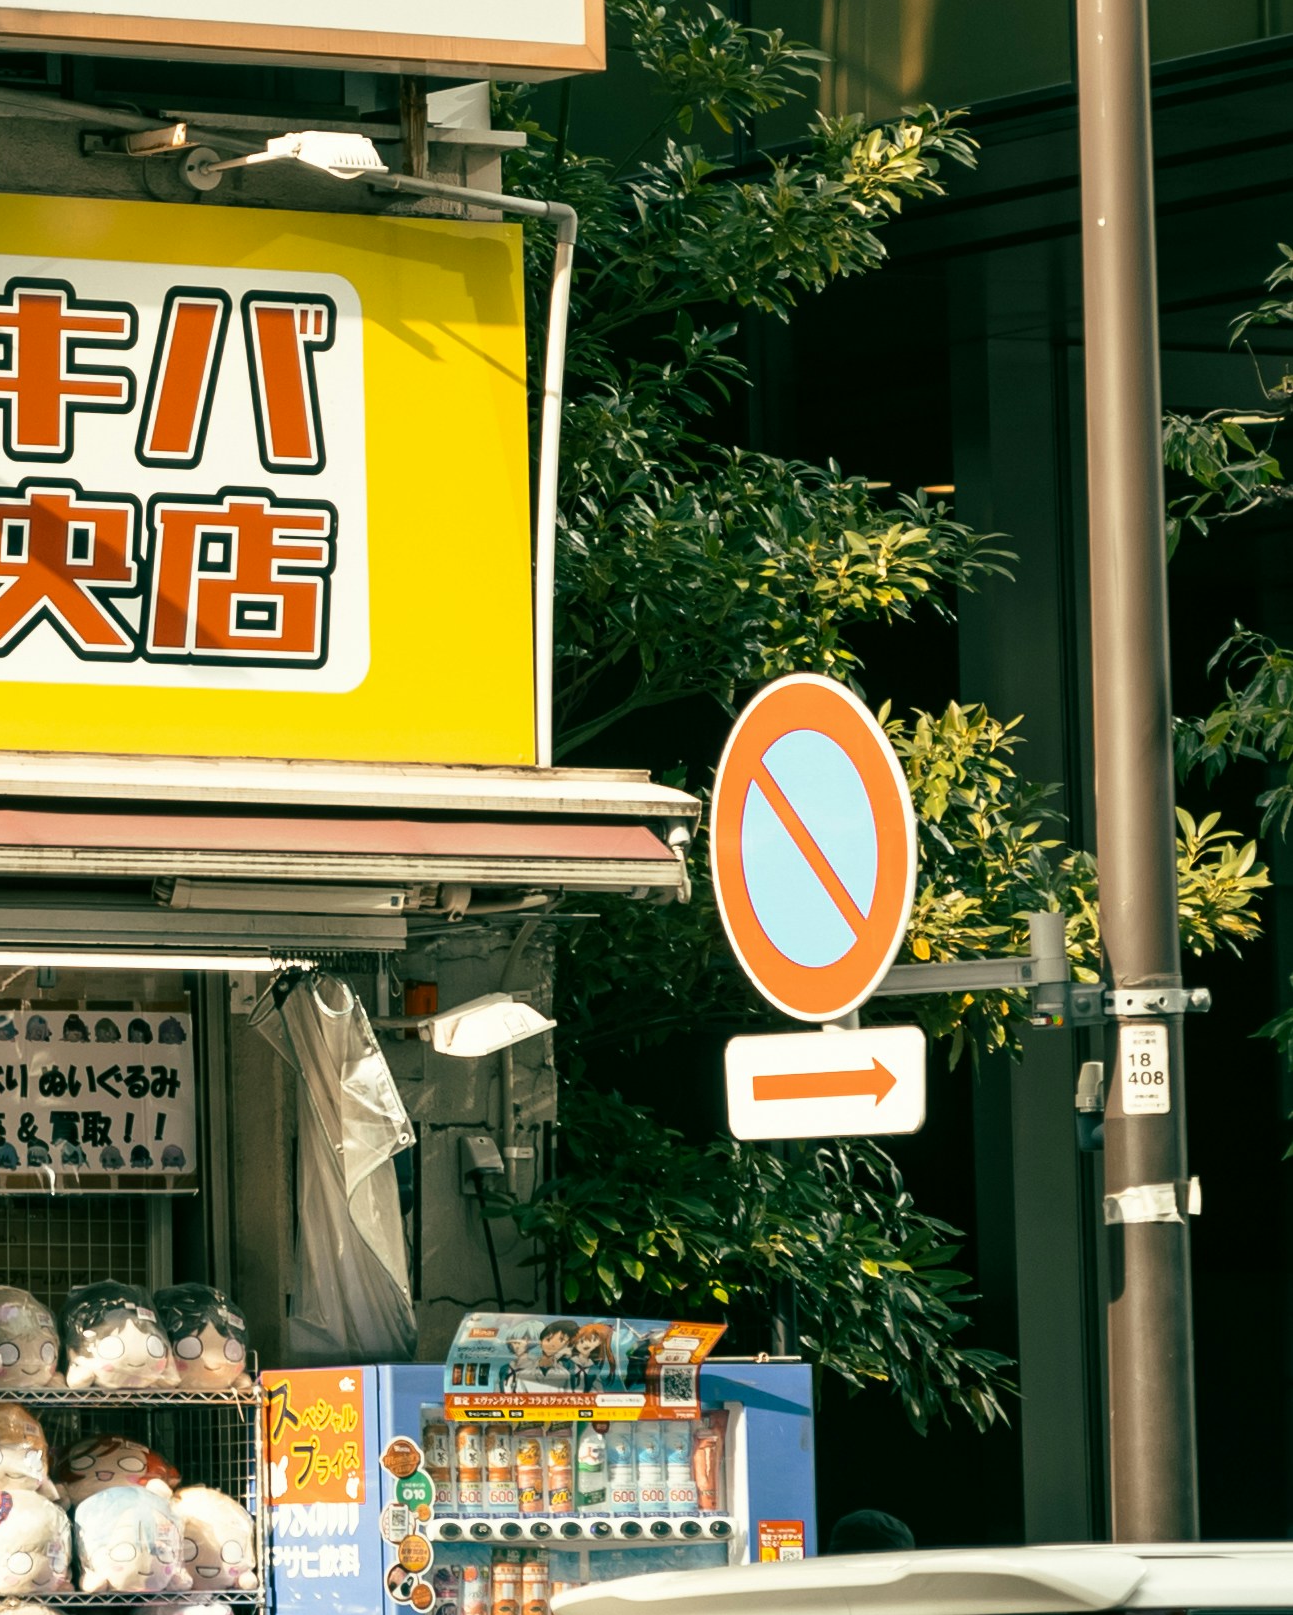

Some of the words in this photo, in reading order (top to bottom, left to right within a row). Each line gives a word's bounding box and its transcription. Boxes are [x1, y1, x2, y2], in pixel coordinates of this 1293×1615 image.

[1128, 1052, 1142, 1067] 18
[38, 1063, 182, 1100] ぬいぐるみ
[1128, 1071, 1164, 1085] 408
[17, 1111, 39, 1144] &
[473, 1396, 527, 1407] エヴァンゲリオン
[270, 1378, 358, 1444] スペシャル
[291, 1434, 360, 1490] プライス
[459, 1490, 482, 1503] 600
[490, 1490, 514, 1503] 600
[613, 1490, 636, 1503] 600
[642, 1489, 664, 1502] 600
[670, 1489, 693, 1502] 600
